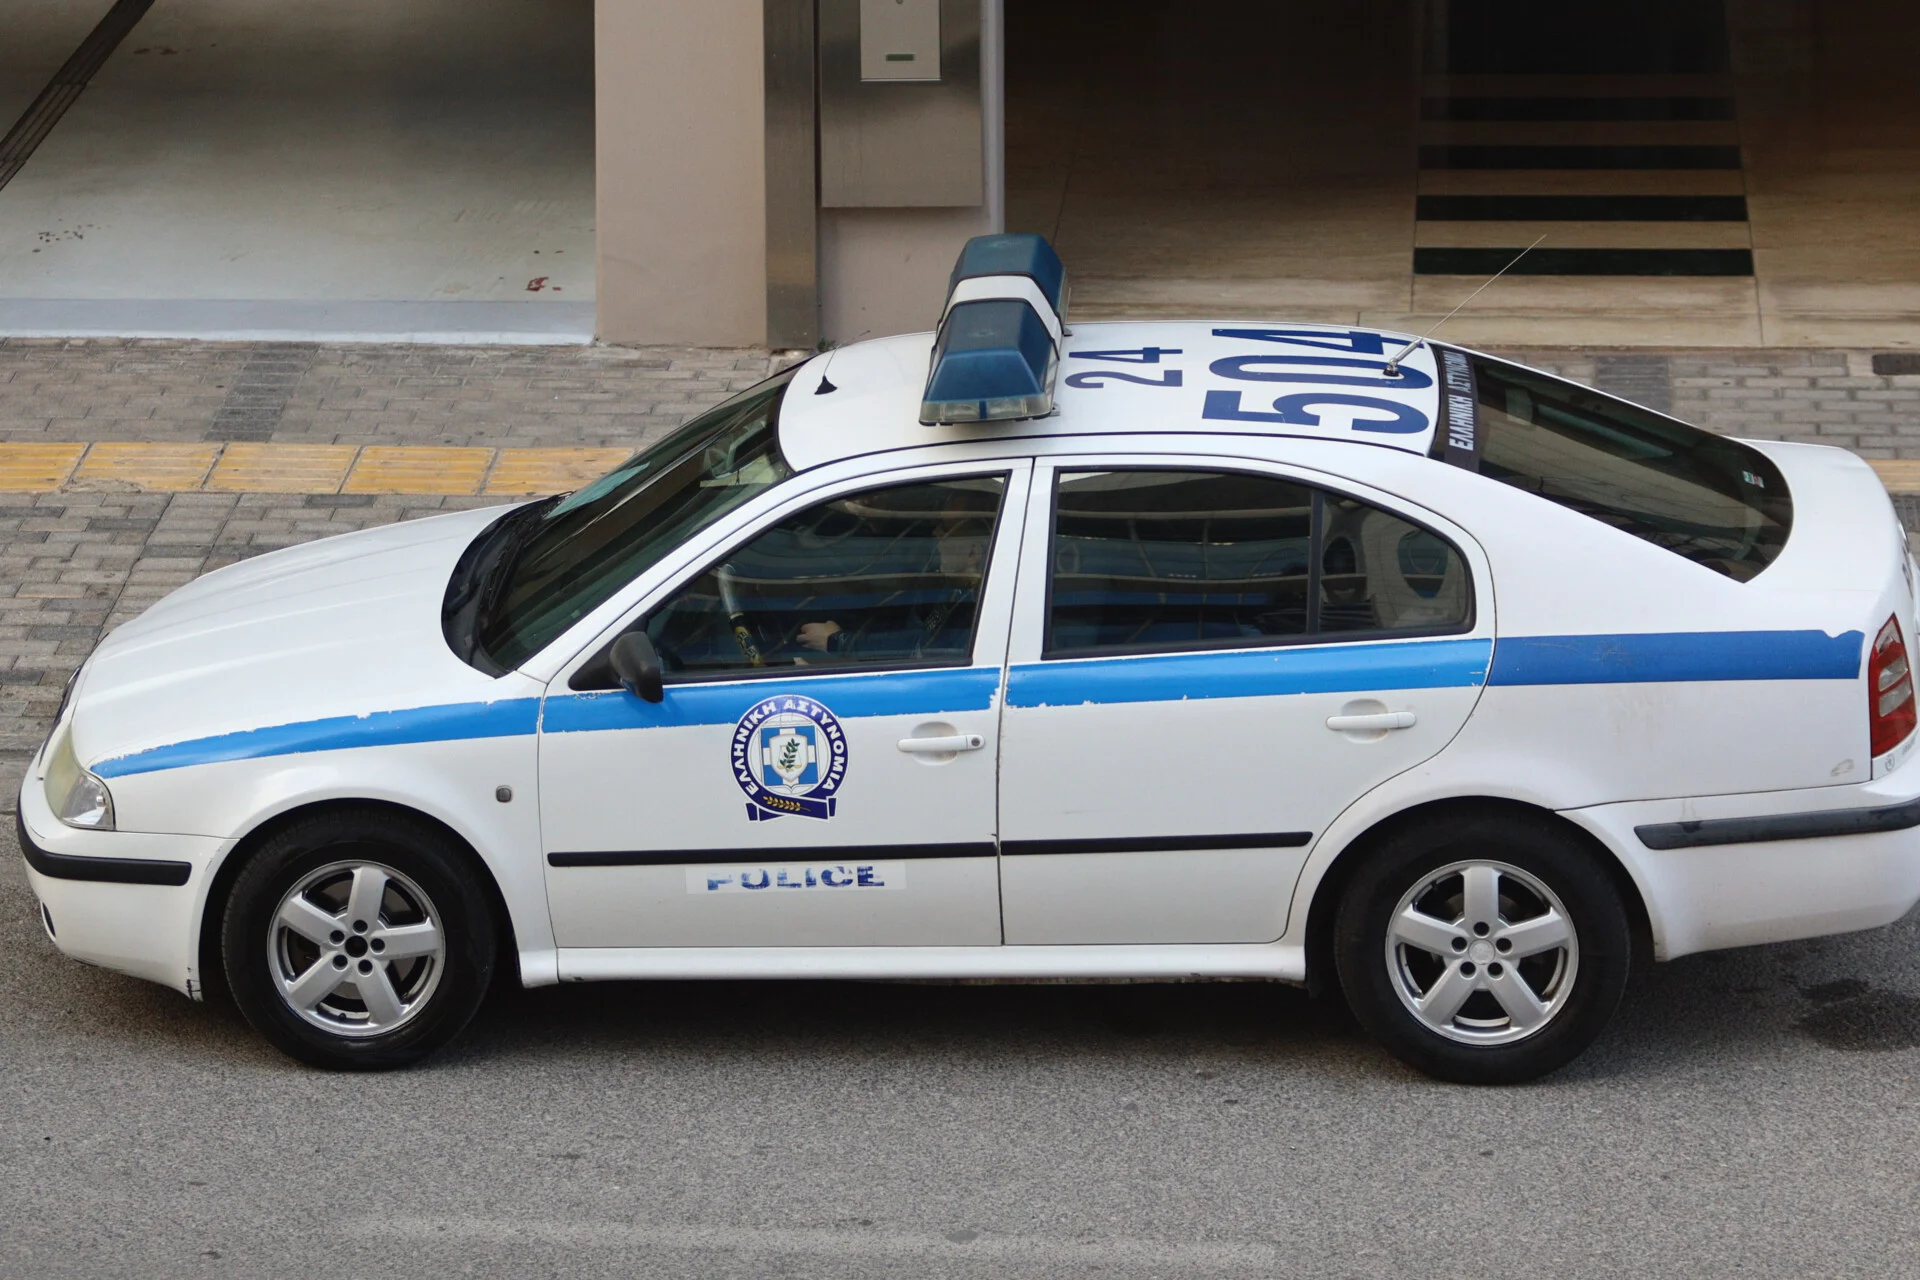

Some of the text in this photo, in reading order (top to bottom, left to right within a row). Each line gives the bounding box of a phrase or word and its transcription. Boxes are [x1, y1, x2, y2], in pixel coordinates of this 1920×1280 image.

[1065, 346, 1183, 389] 24
[1202, 328, 1433, 434] 504
[1448, 394, 1474, 451] ΕΛΛΗΝΙΚΗ
[733, 699, 845, 796] ΕΛΛΗΝΙΚΗ ΑΣΤΥΝΟΜΙΑ
